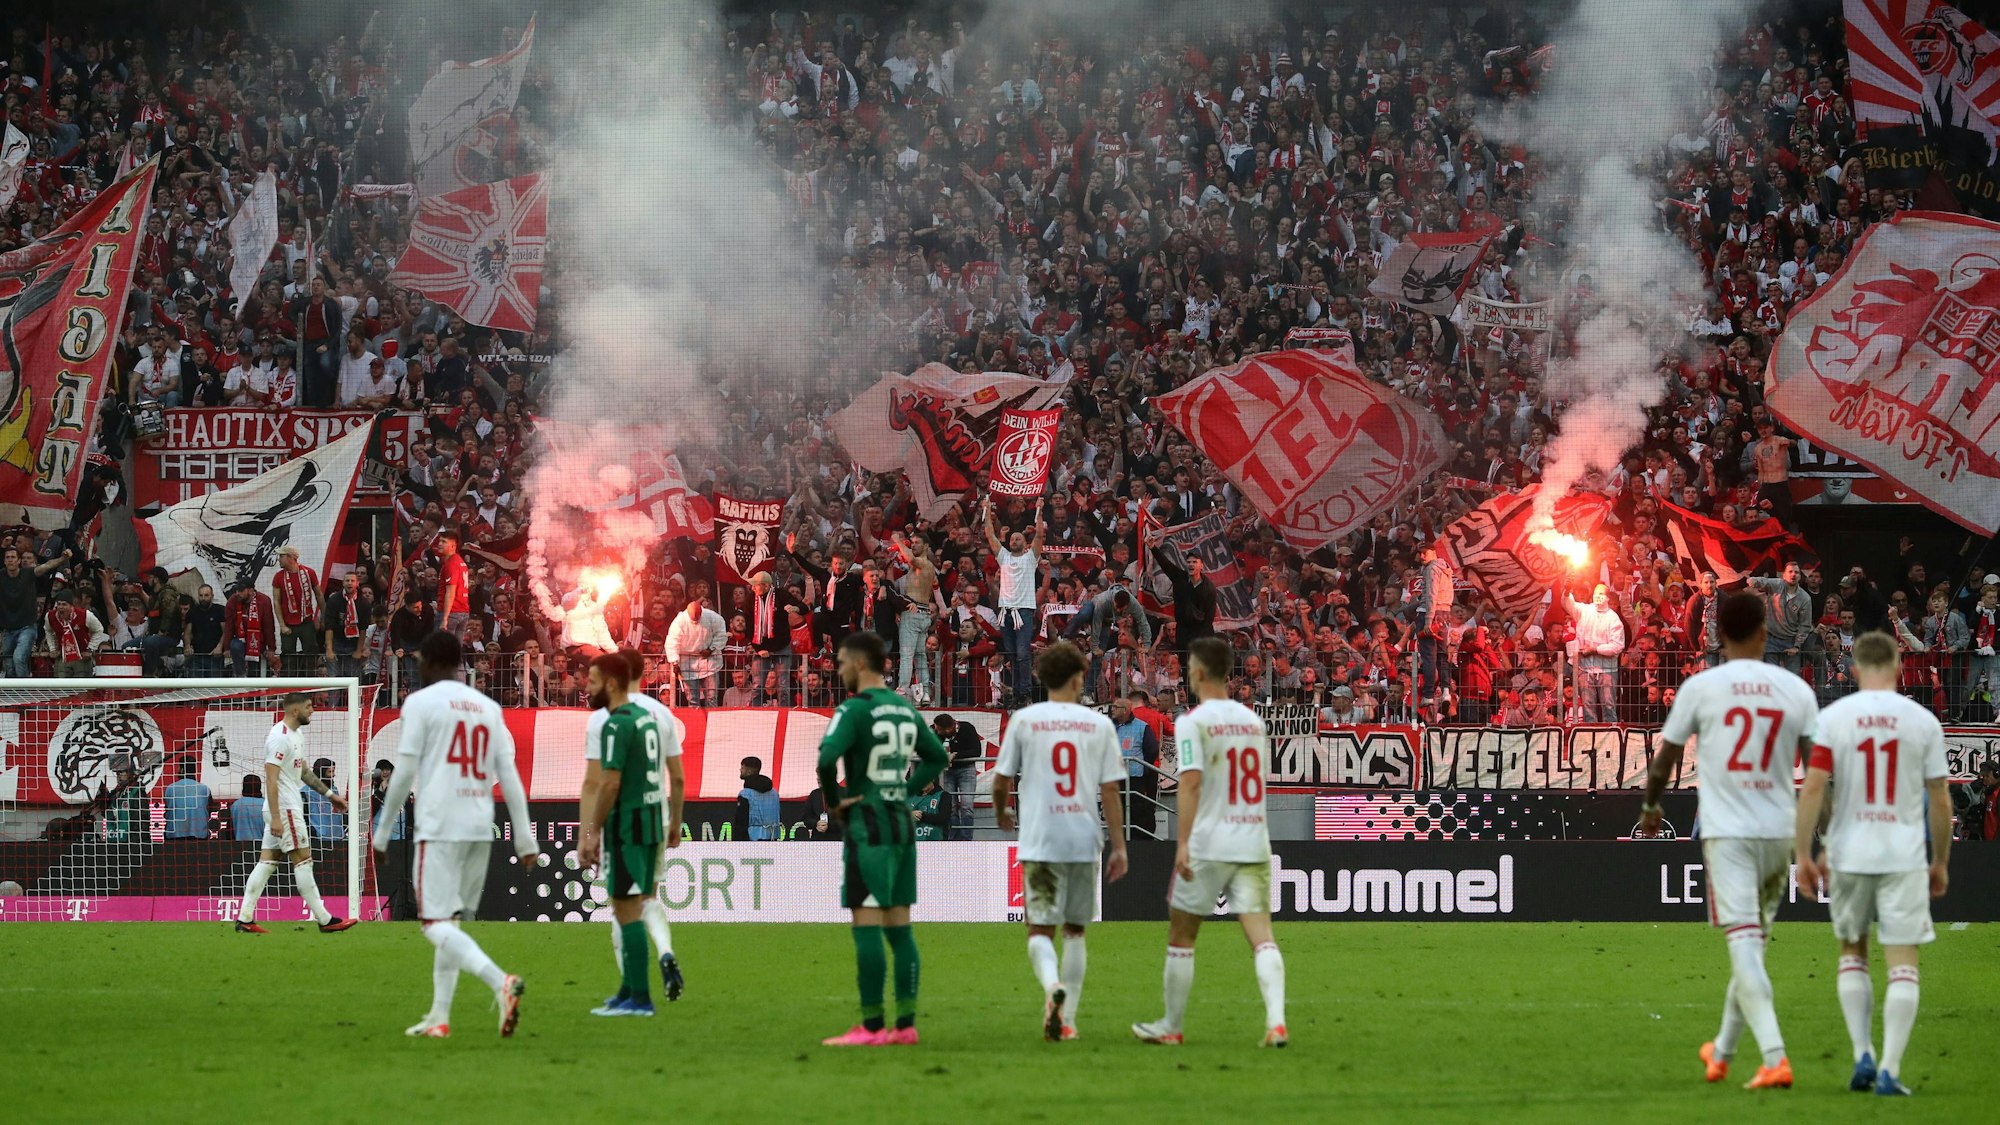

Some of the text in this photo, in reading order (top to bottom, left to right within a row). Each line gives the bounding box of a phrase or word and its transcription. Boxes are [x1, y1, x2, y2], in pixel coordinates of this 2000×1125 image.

[1914, 52, 1930, 66] ÖLN
[1461, 298, 1548, 329] FENTE
[1002, 412, 1029, 429] DEIN
[1291, 456, 1401, 531] KÖLN
[1731, 682, 1773, 699] SELKE
[447, 720, 489, 781] 40
[1030, 721, 1097, 734] WALDSCHMIDT
[1723, 706, 1785, 773] 27
[1856, 716, 1898, 731] KAINZ
[644, 728, 661, 784] 9
[866, 720, 918, 785] 29
[1051, 740, 1078, 798] 9
[1226, 745, 1263, 806] 18
[1856, 736, 1898, 805] 11
[1635, 829, 1672, 840] SRT
[1270, 854, 1514, 914] hummel
[1007, 912, 1024, 922] BU
